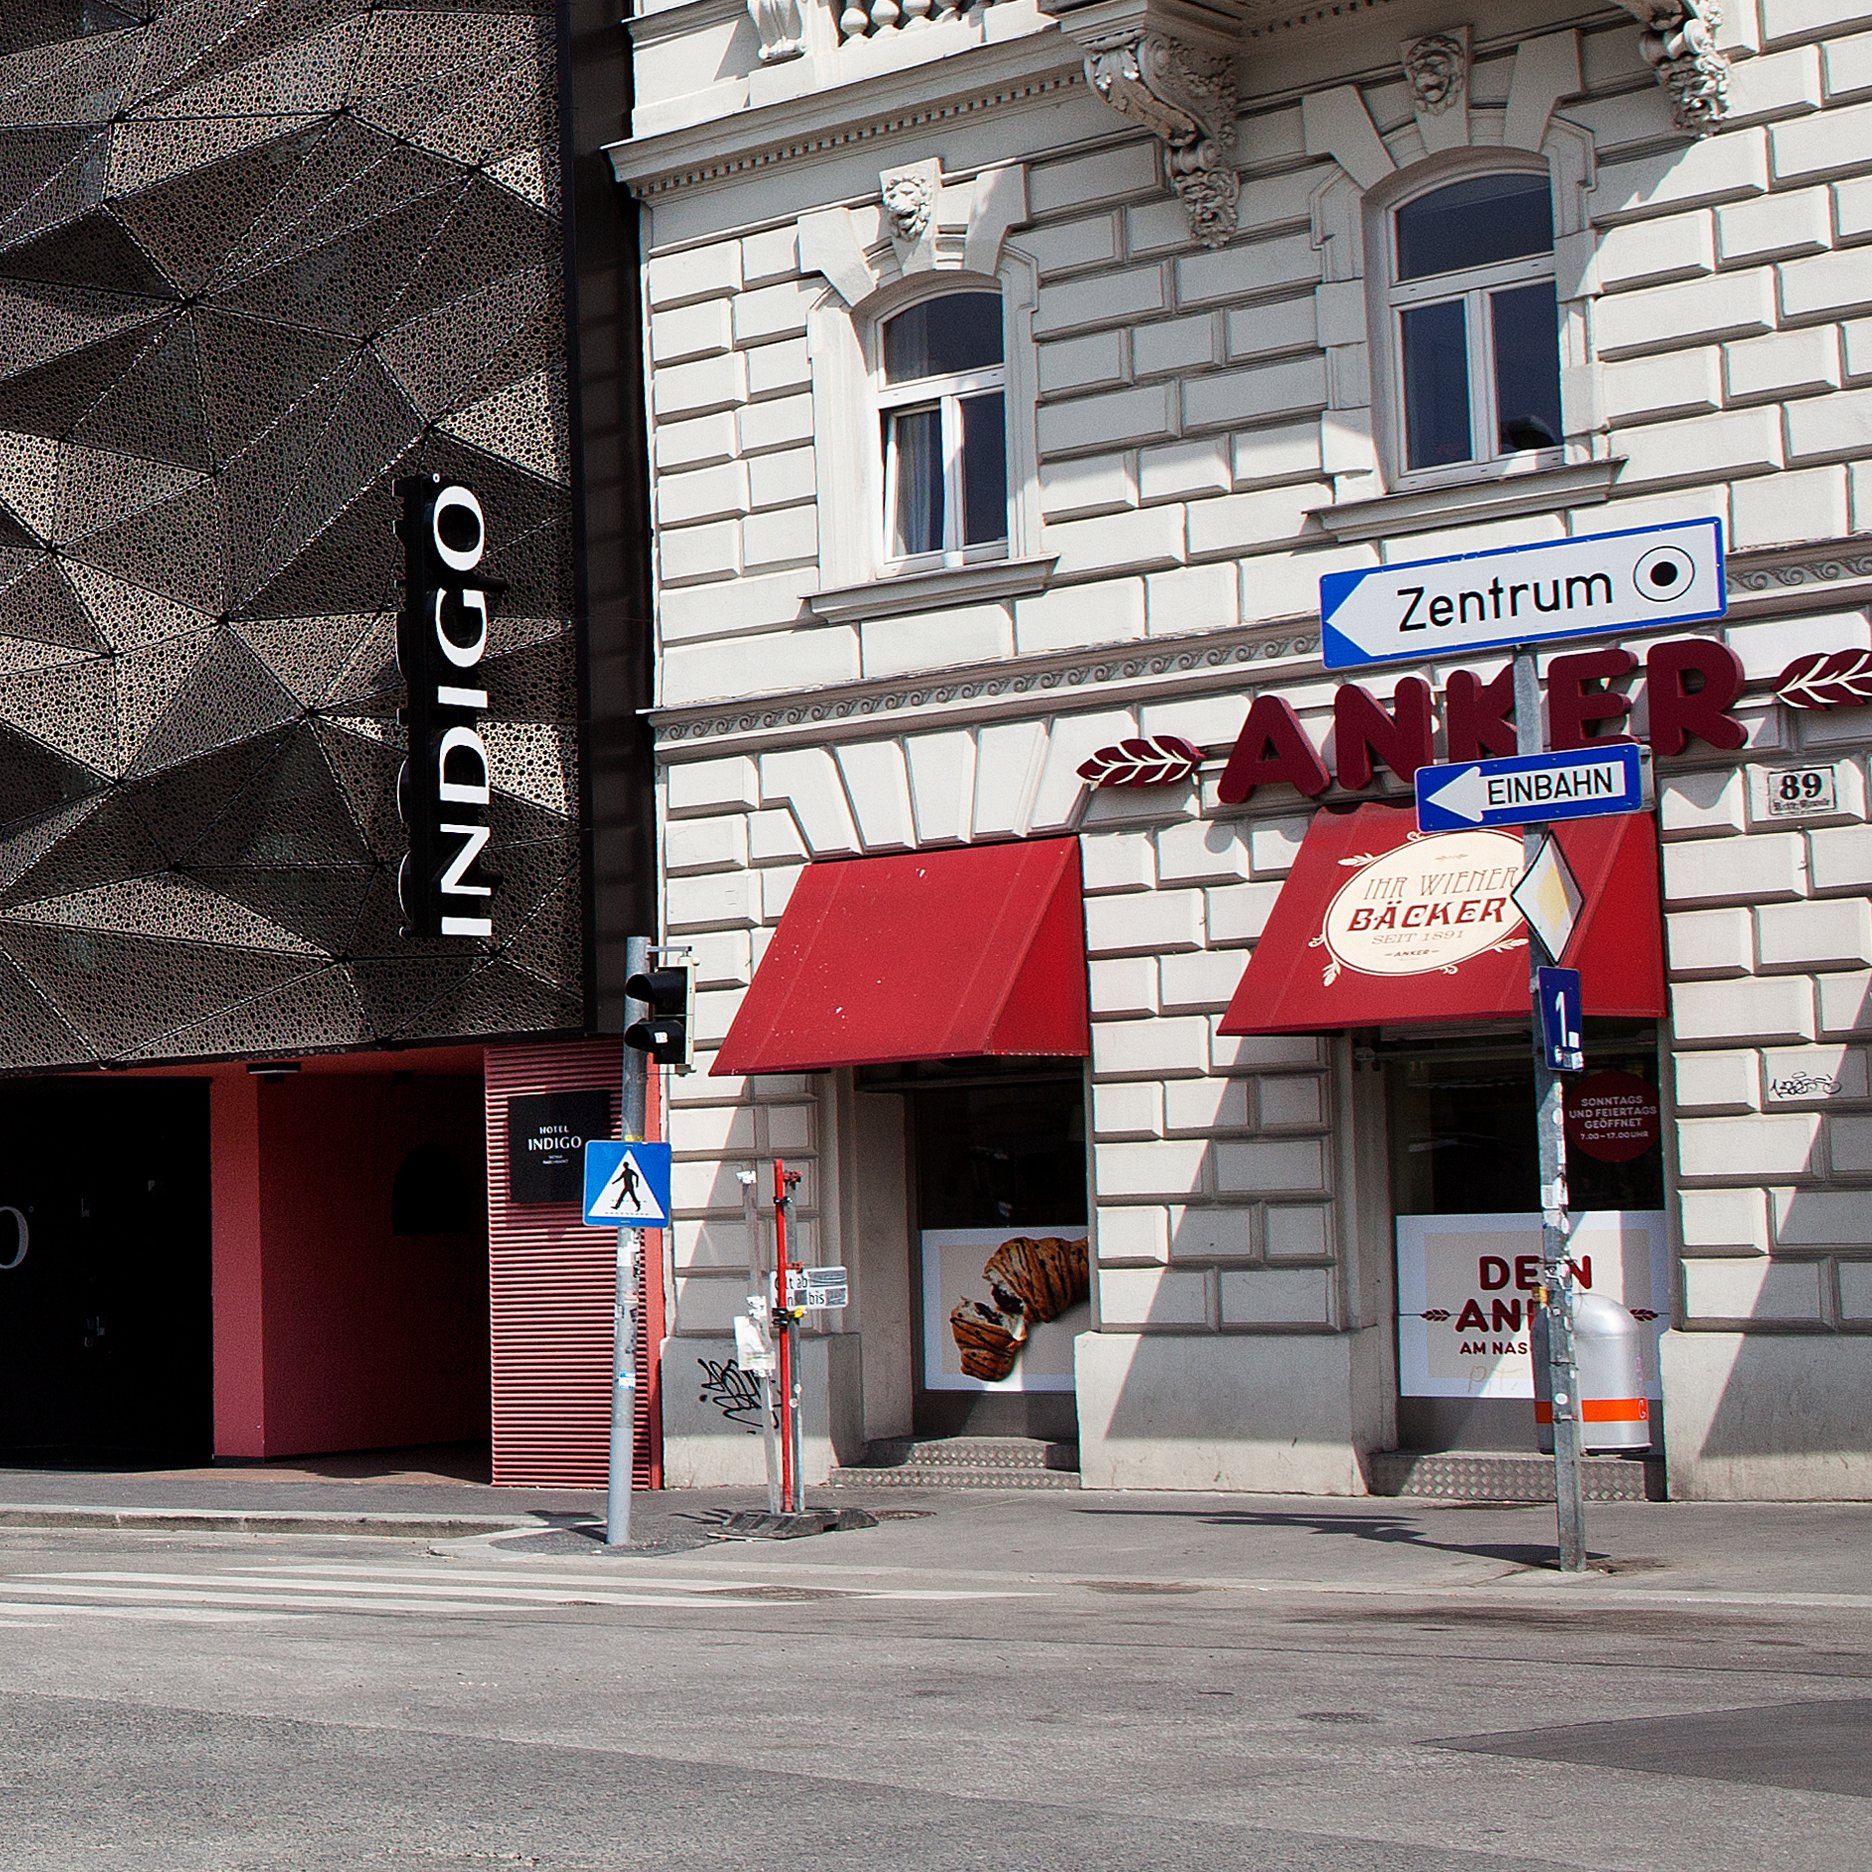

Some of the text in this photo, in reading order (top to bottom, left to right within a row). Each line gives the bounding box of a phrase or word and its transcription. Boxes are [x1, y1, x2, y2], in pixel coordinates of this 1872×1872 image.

[1396, 572, 1614, 633] Zentrum
[433, 484, 492, 937] INDIGO
[1217, 638, 1748, 804] ANKER
[1486, 765, 1614, 806] EINBAHN
[1779, 773, 1823, 800] 89
[1363, 866, 1519, 901] IHR WIENER
[1346, 896, 1508, 932] BÄCKER
[1371, 930, 1464, 945] SEIT 1891
[1580, 1095, 1644, 1107] SONNTAGS
[1568, 1105, 1657, 1119] UND FEIERTAGS
[539, 1124, 569, 1135] HOTEL
[1583, 1117, 1643, 1129] GEÖFFNET
[527, 1135, 582, 1151] INDIGO
[1478, 1255, 1593, 1291] DEN
[809, 1291, 825, 1305] bis
[1459, 1341, 1528, 1355] AM NAS
